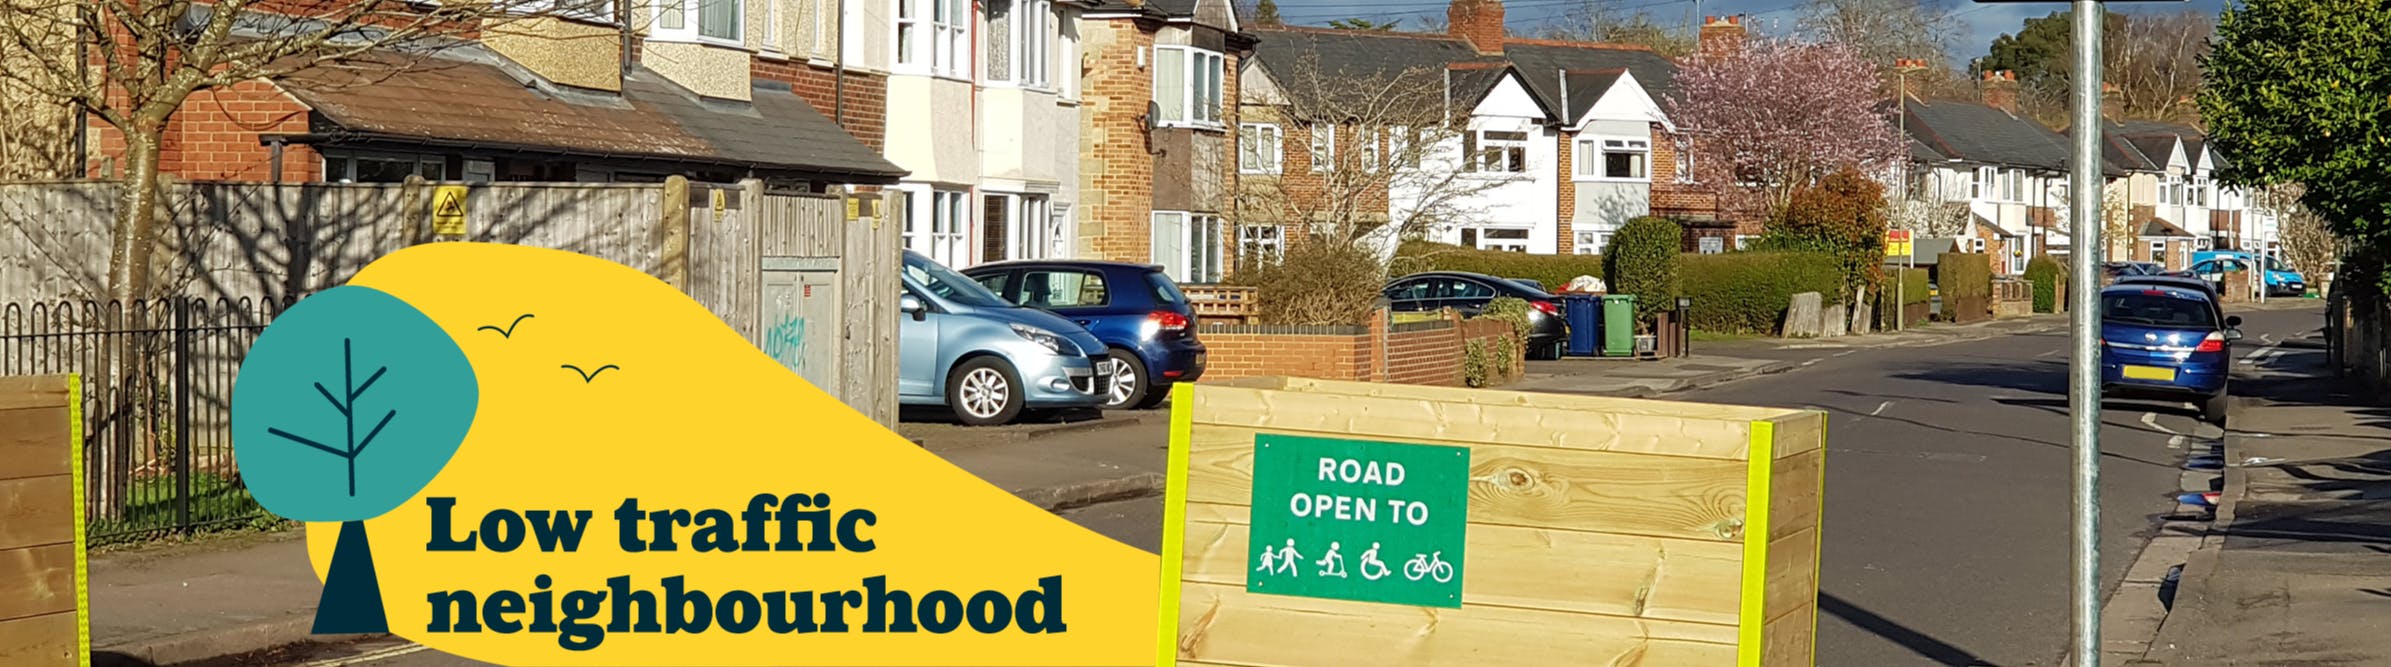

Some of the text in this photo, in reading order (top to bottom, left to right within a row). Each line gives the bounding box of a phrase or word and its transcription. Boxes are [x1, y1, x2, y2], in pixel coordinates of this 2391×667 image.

[1318, 457, 1406, 486] ROAD
[1290, 492, 1429, 526] OPEN TO
